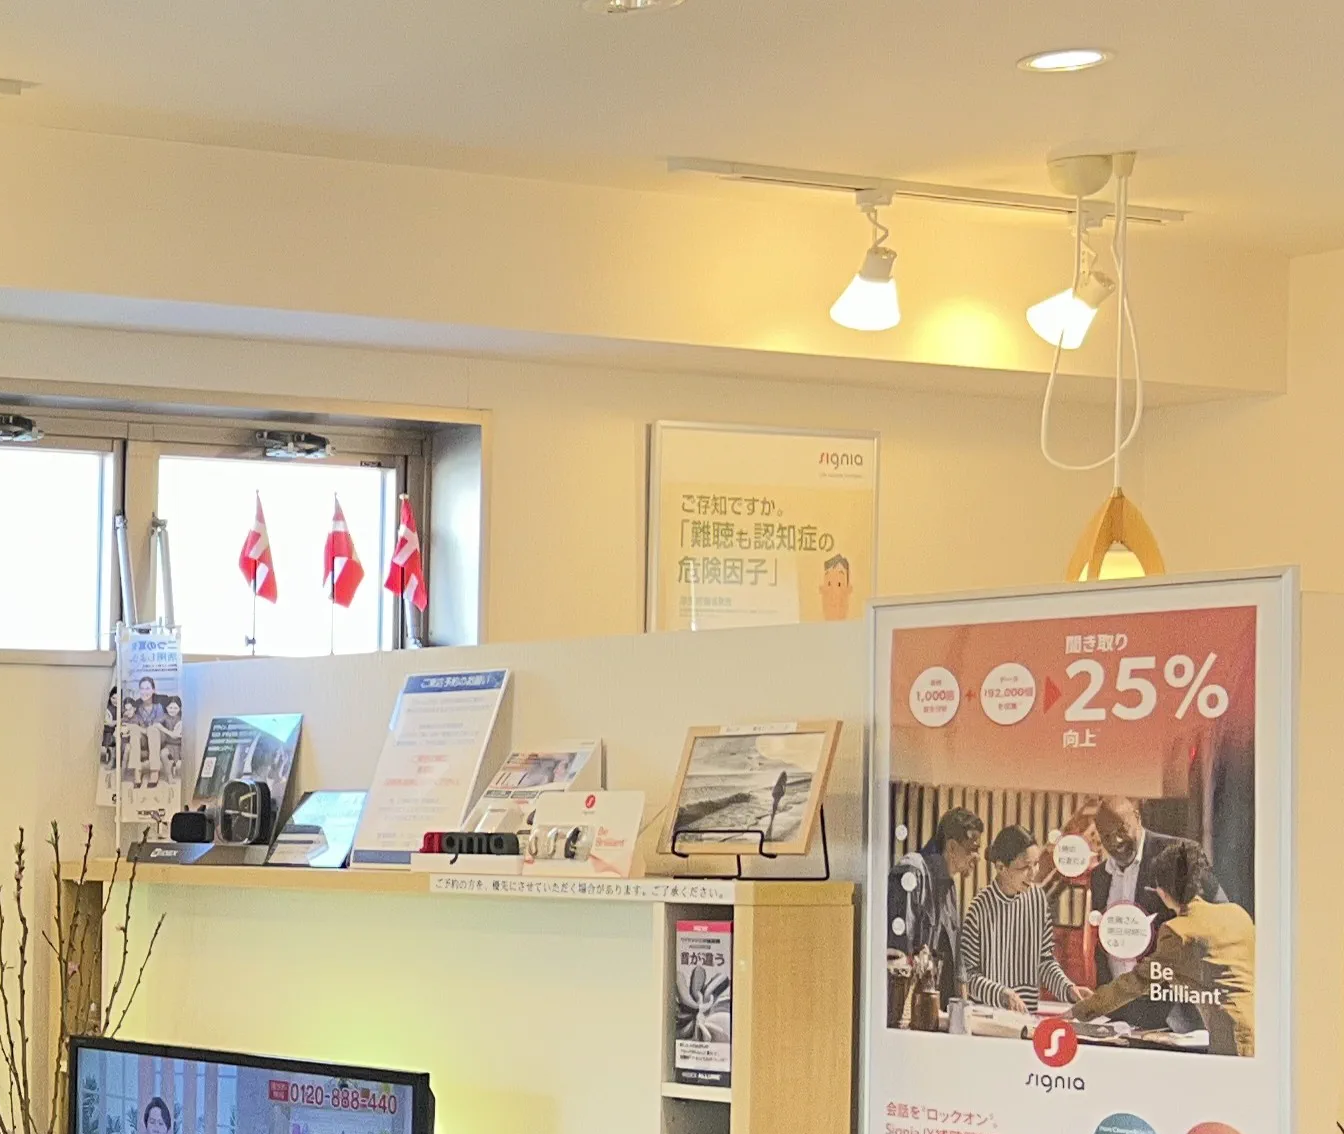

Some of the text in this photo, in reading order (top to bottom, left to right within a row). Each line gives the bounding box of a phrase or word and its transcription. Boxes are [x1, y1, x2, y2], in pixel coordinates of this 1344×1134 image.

[818, 451, 864, 470] signia
[681, 494, 784, 517] ご存知ですか。
[680, 518, 835, 552] 「難聴も認知症の
[677, 556, 779, 587] 危険因子」
[1064, 633, 1129, 655] 聞き取り
[1063, 651, 1230, 722] 25%
[1061, 729, 1097, 749] 向上
[1149, 961, 1174, 980] Be
[1149, 982, 1222, 1005] Brilliant
[1024, 1071, 1086, 1093] signia
